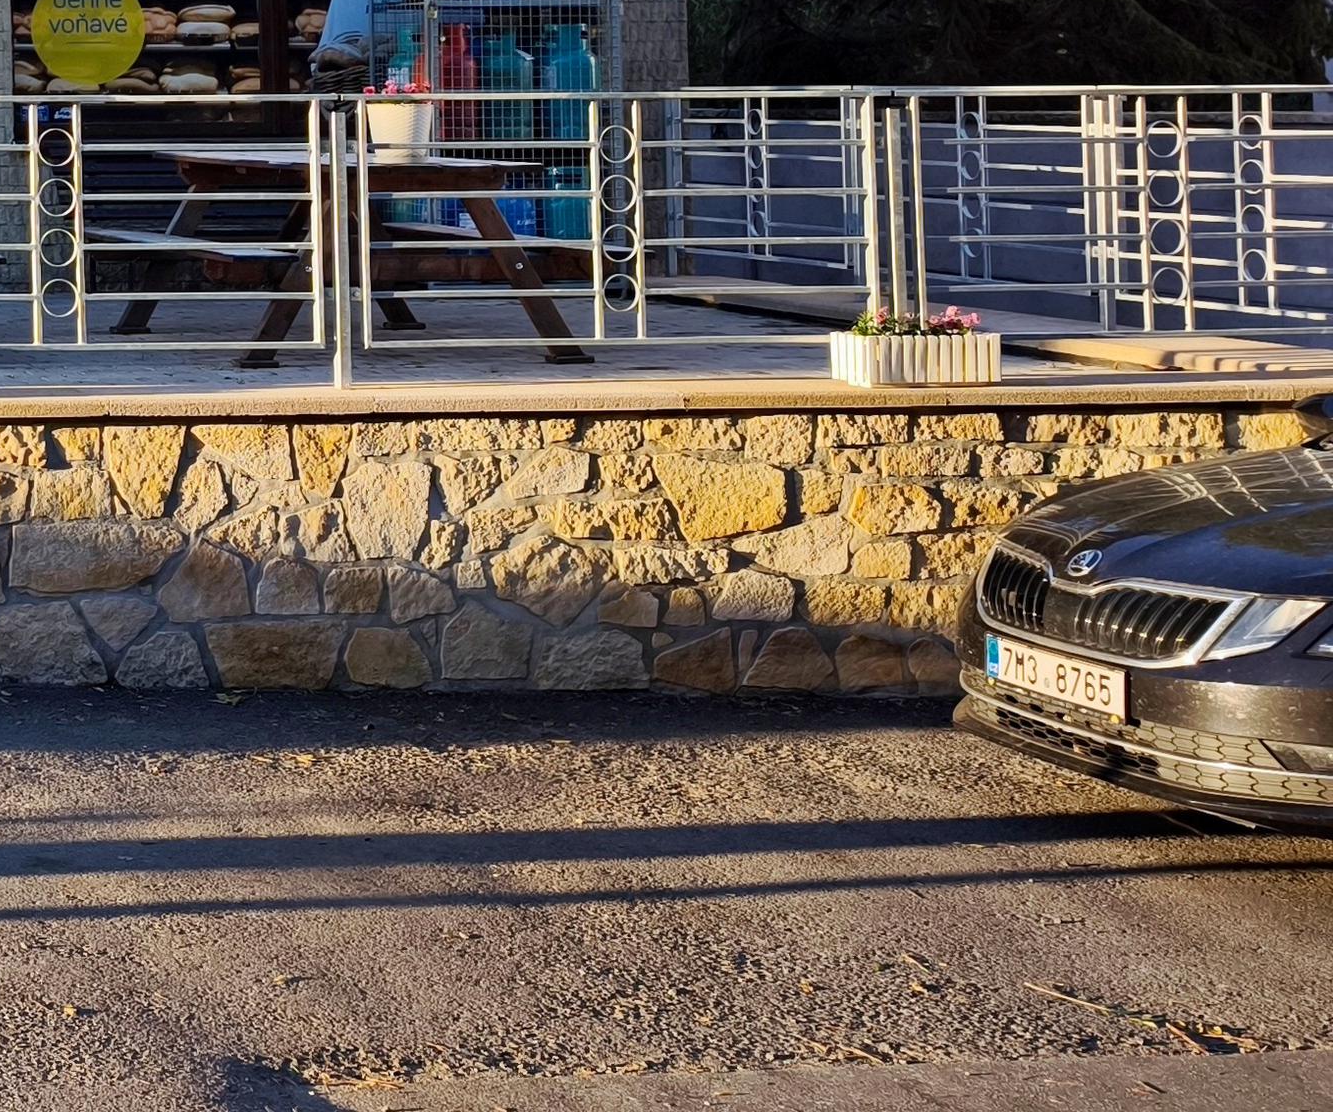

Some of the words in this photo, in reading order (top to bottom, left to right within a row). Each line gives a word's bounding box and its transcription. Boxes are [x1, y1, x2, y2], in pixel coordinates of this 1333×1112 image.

[48, 12, 128, 34] voňavé
[1003, 647, 1038, 685] 7M3
[1056, 663, 1111, 706] 8765
